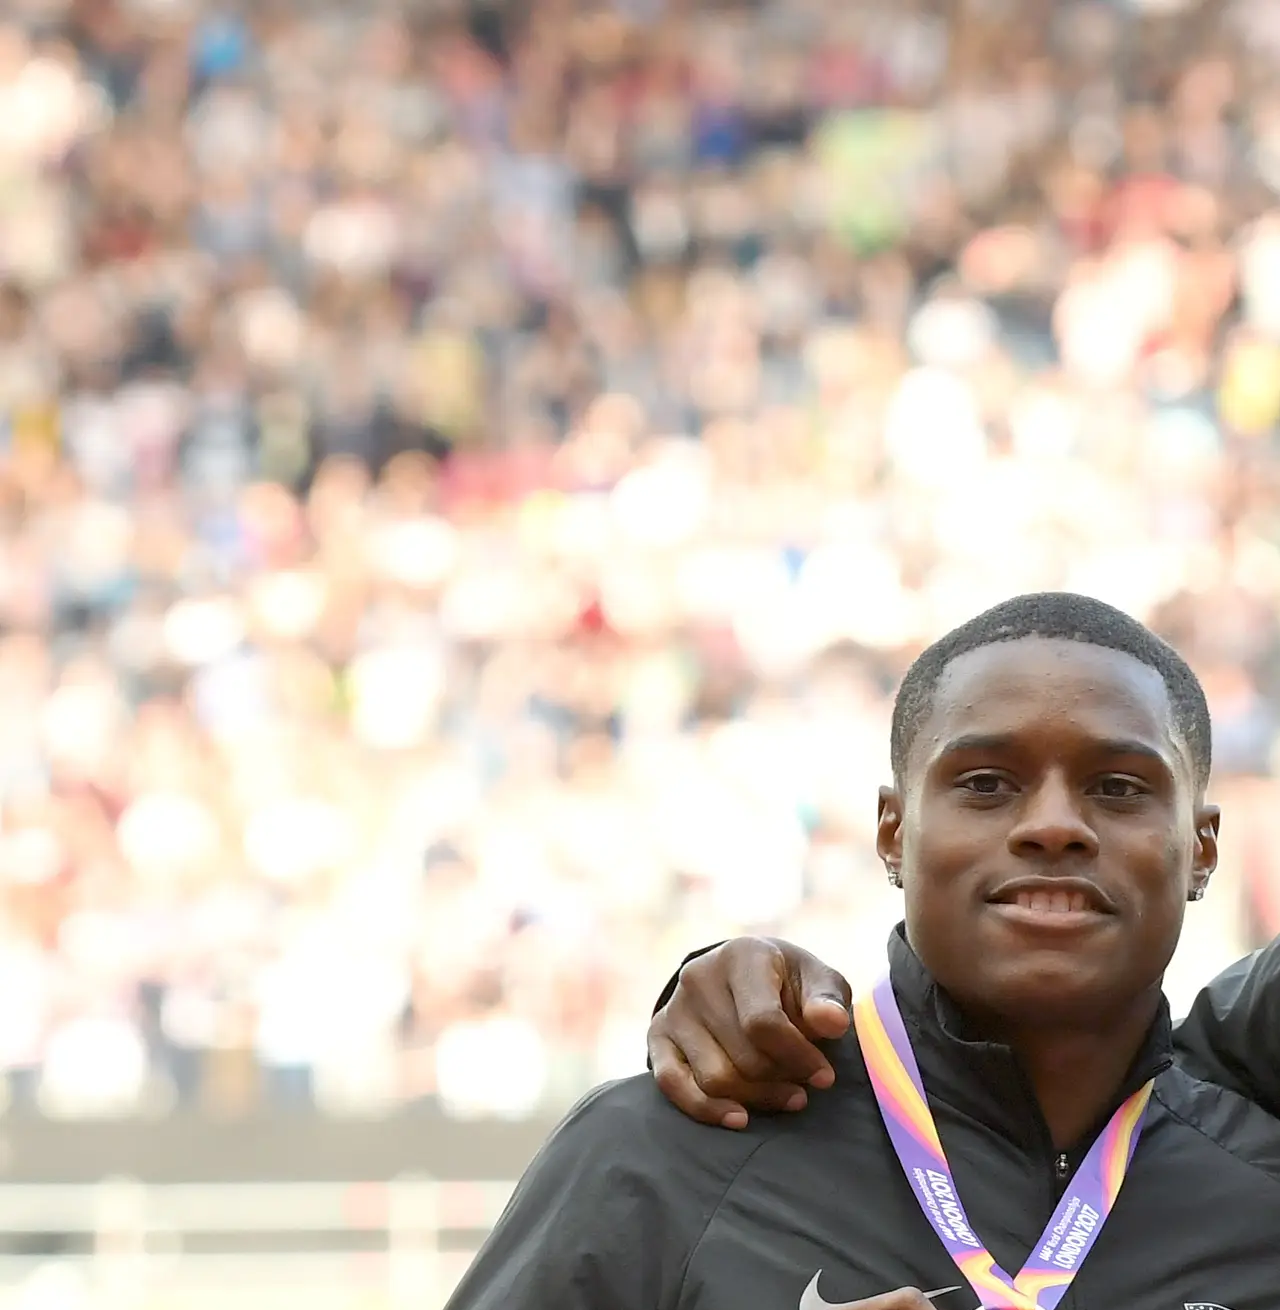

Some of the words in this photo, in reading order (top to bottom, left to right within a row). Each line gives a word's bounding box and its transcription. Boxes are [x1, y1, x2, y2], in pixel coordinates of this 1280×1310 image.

[926, 1169, 955, 1200] 2017
[938, 1199, 980, 1248] LONDON
[1052, 1226, 1090, 1269] LONDON
[1074, 1203, 1100, 1233] 2017
